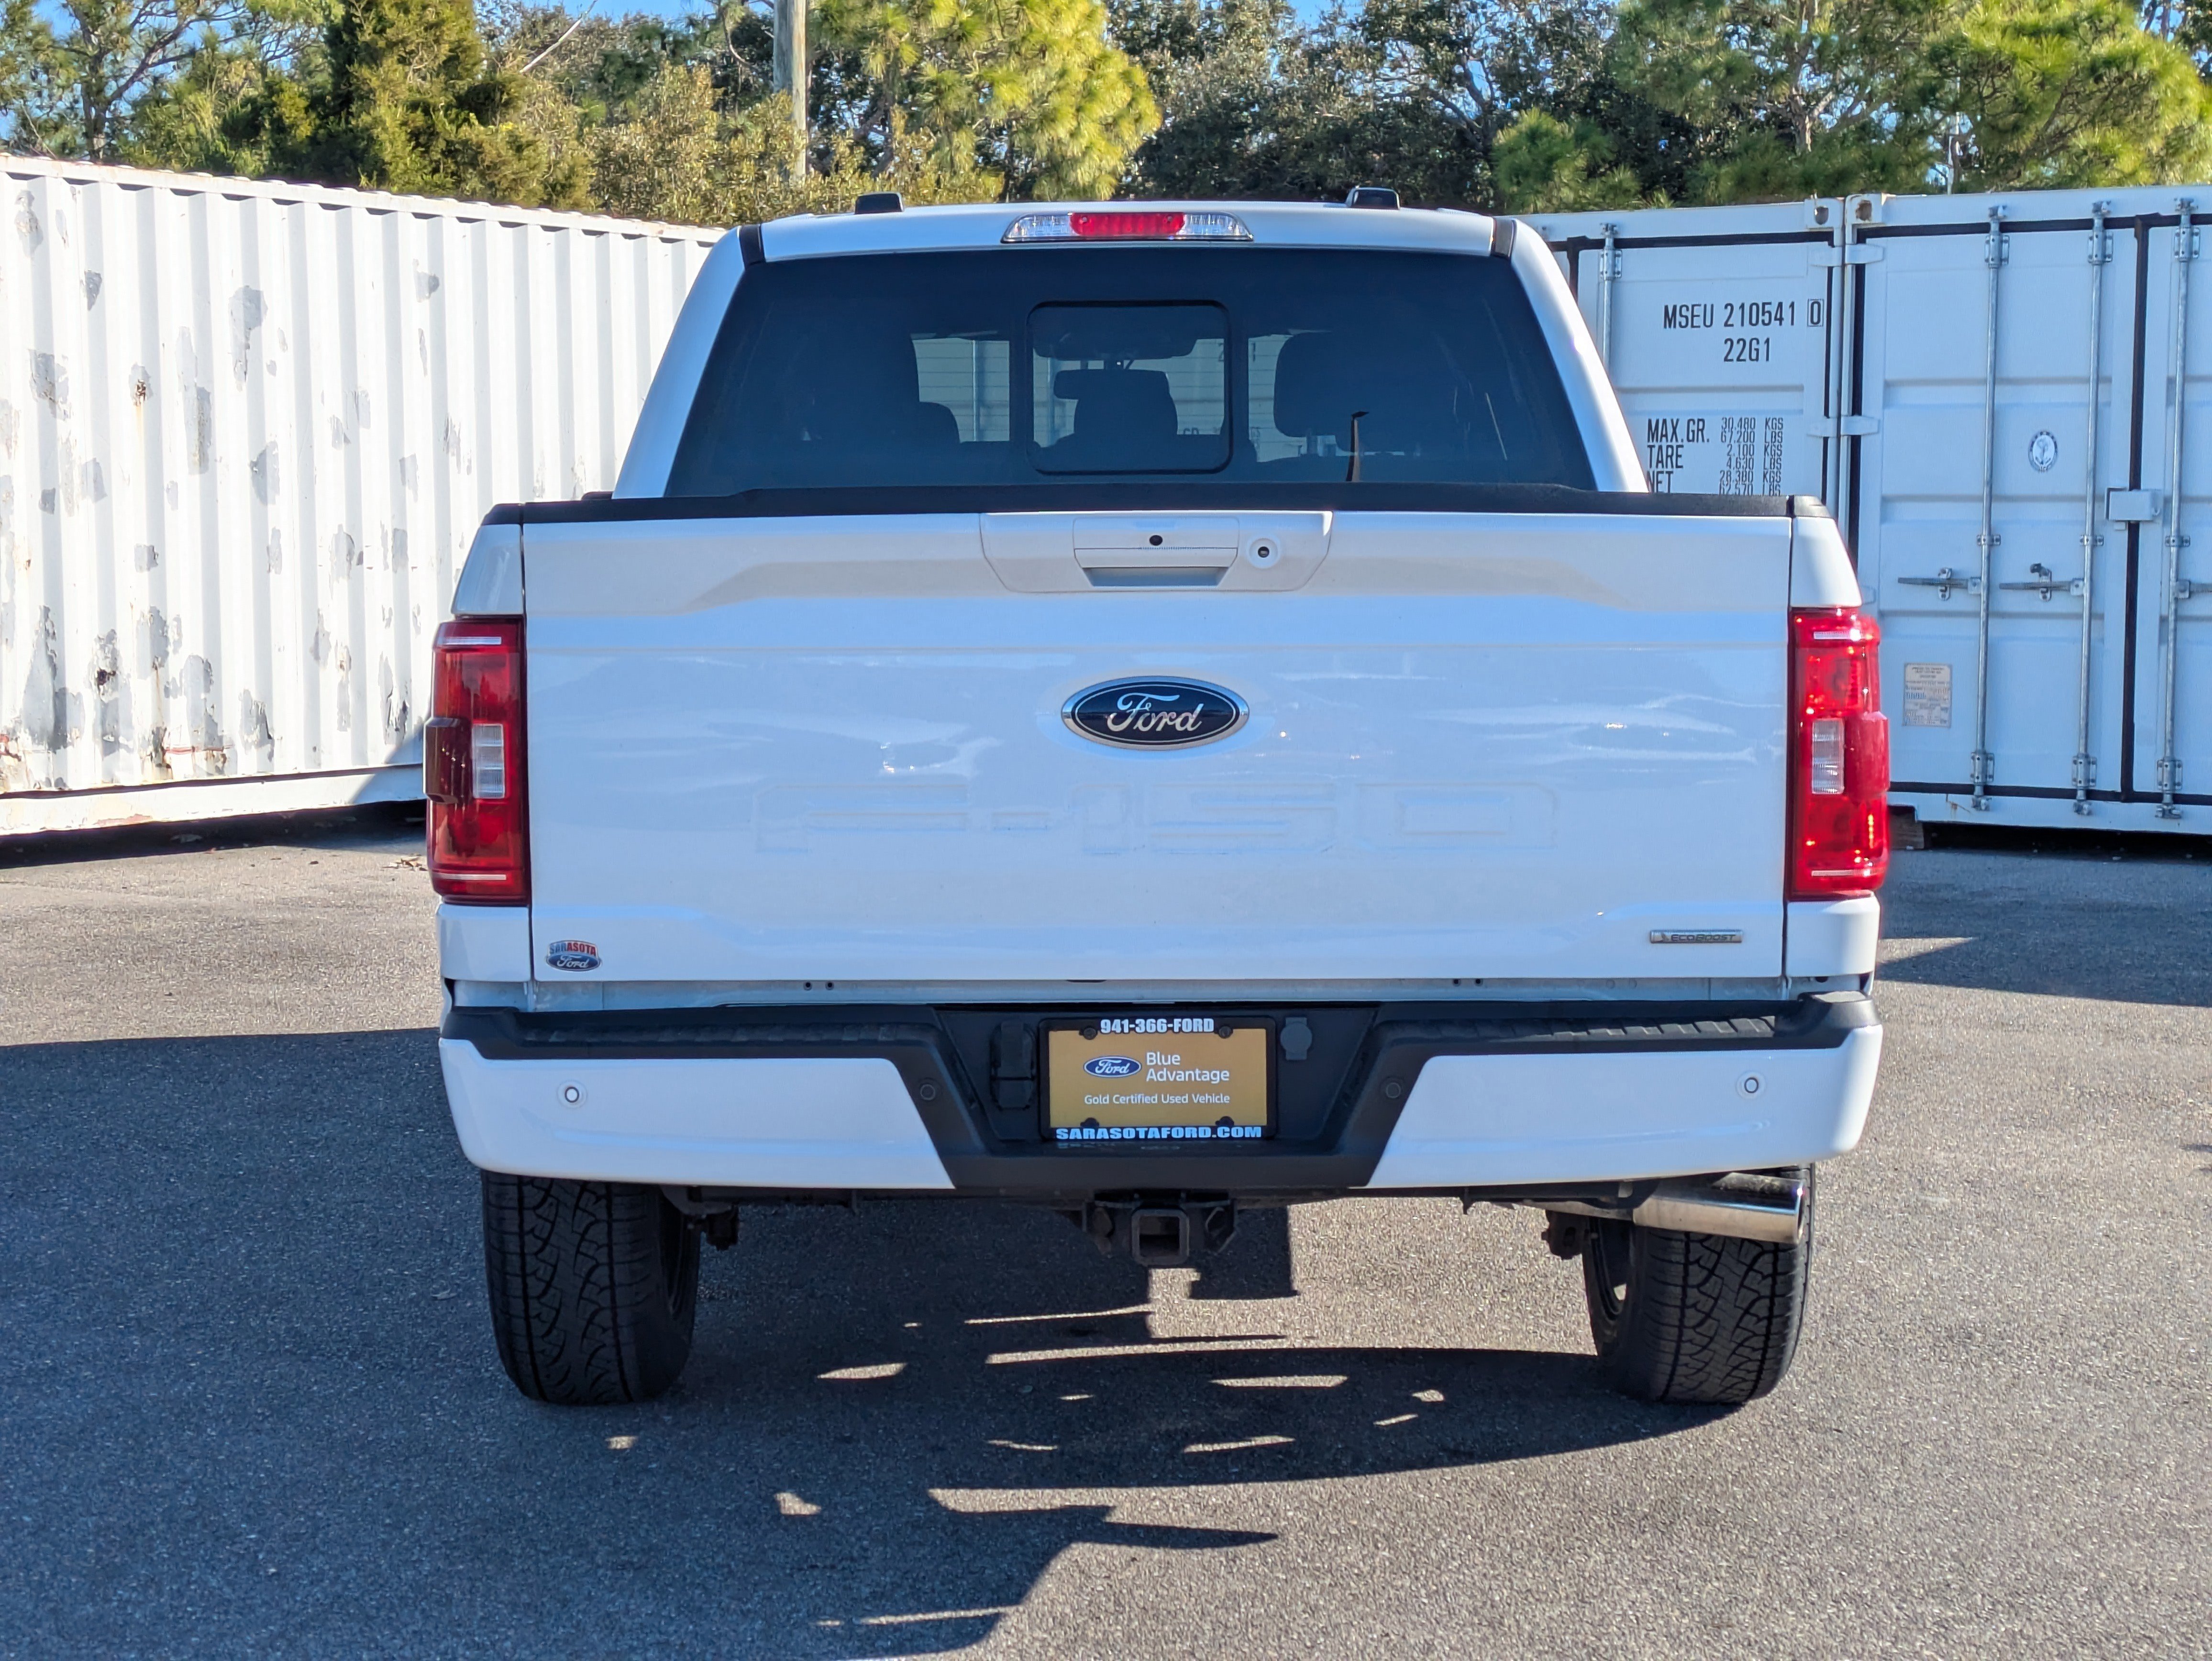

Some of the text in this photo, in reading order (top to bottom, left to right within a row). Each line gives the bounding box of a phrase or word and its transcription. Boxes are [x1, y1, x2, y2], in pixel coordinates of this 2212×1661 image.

[1663, 300, 1822, 329] MSEU 210541 0
[1723, 337, 1770, 362] 22G1
[1647, 418, 1710, 443] MAX.GR.
[1721, 417, 1783, 431] 30.480 KGS
[1764, 431, 1783, 443] LBS
[1647, 444, 1684, 469] TARE
[1764, 443, 1782, 457] KGS
[1647, 470, 1674, 494] NET
[1763, 470, 1781, 483] KGS
[1106, 692, 1204, 732] Ford
[754, 782, 1558, 854] F-150
[1670, 934, 1736, 942] ECOBOOST
[549, 941, 597, 957] SARASOTA
[556, 955, 590, 968] Ford
[1100, 1018, 1215, 1033] 941-366-FORD
[1146, 1052, 1181, 1065] Blue
[1094, 1059, 1130, 1074] Ford
[1146, 1068, 1229, 1084] Advantage
[1084, 1093, 1230, 1105] Gold Certified Used Vehicle
[1056, 1126, 1262, 1140] SARASOTAFORD.COM
